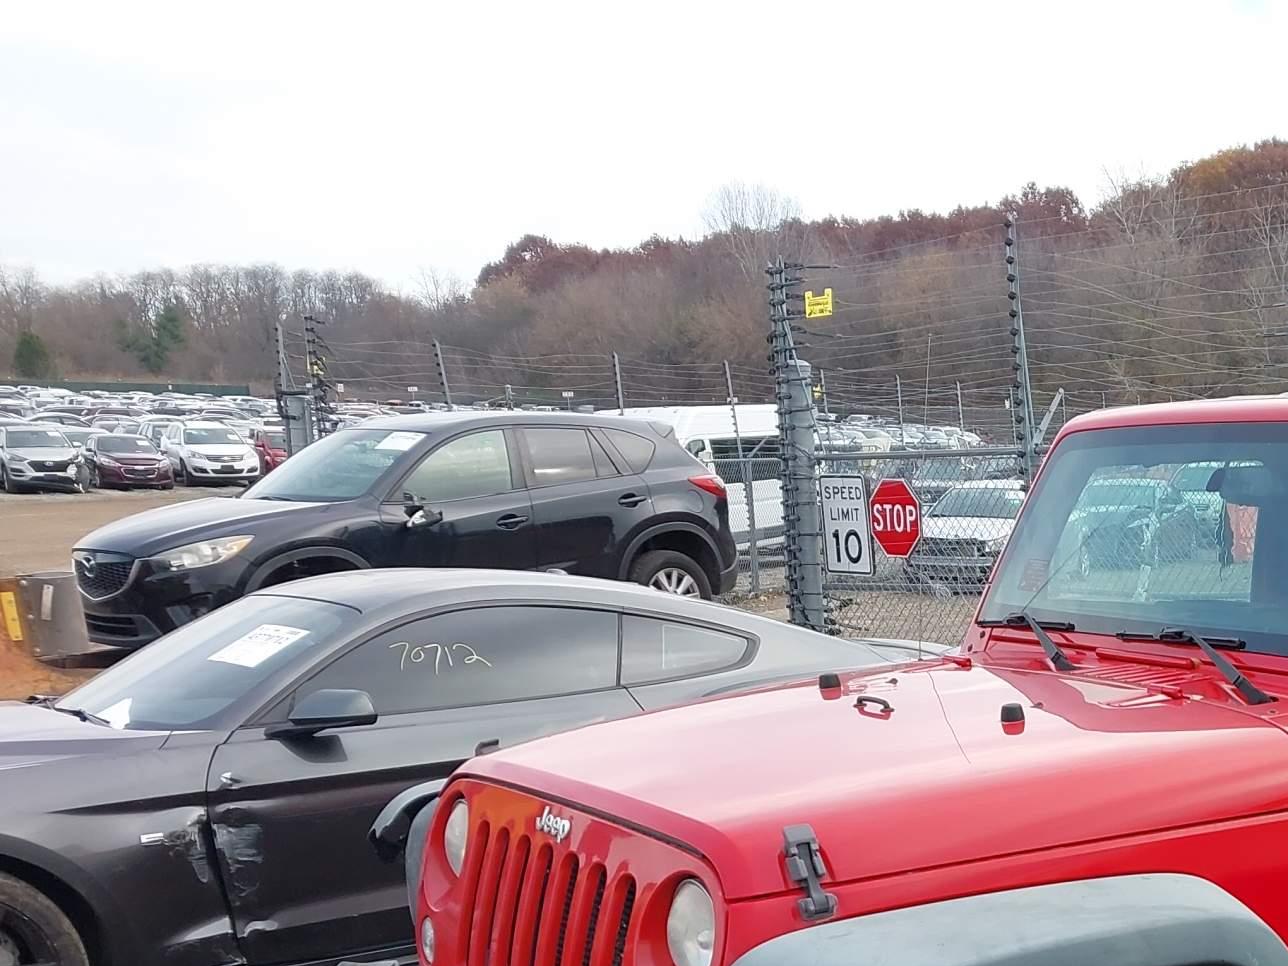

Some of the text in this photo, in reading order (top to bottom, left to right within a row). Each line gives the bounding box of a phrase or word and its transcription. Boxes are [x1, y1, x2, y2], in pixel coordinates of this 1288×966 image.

[824, 486, 861, 500] SPEED
[830, 507, 860, 521] LIMIT
[873, 503, 916, 533] STOP
[832, 529, 863, 564] 10
[389, 642, 492, 675] 70712
[535, 805, 571, 844] Jeep
